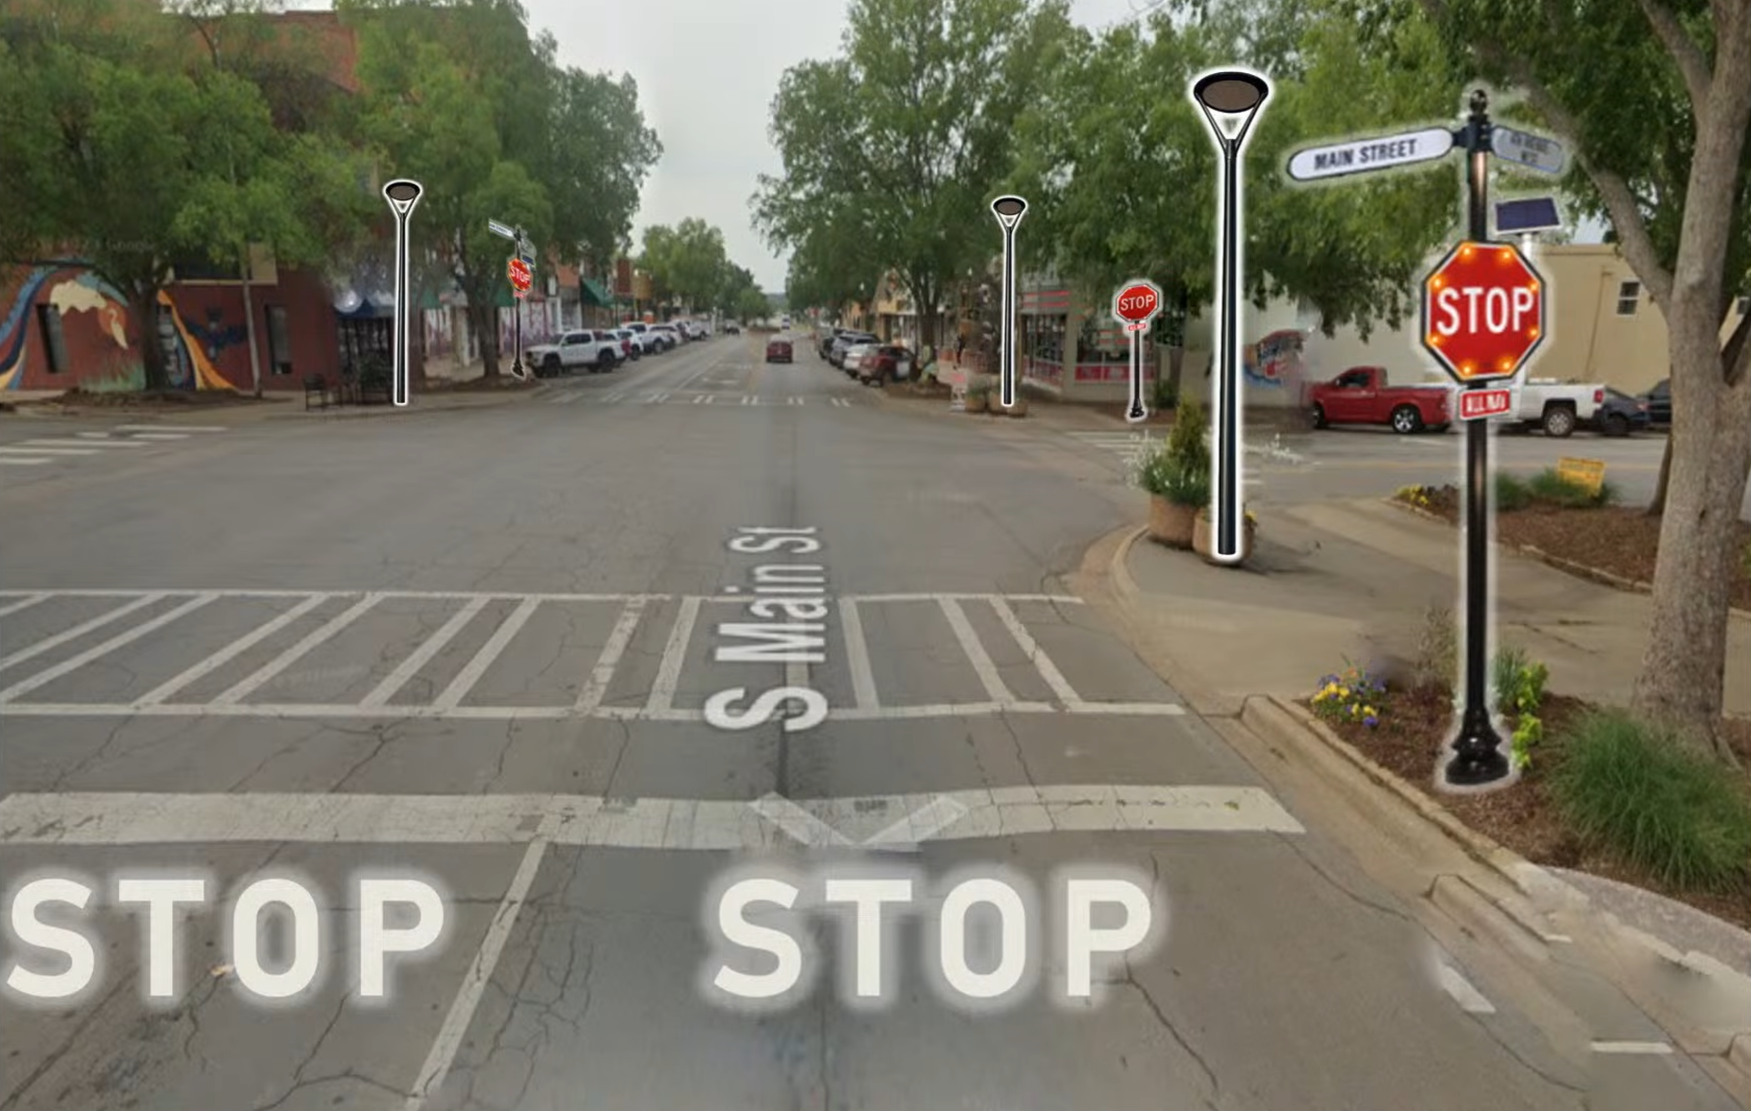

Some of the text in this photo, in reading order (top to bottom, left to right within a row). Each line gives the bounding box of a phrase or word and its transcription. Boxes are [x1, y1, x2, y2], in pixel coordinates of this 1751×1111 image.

[1313, 138, 1417, 171] MAIN STREET
[511, 267, 530, 283] STOP
[1120, 294, 1154, 311] STOP
[1436, 286, 1534, 335] STOP
[6, 878, 445, 998] STOP
[713, 878, 1152, 998] STOP
